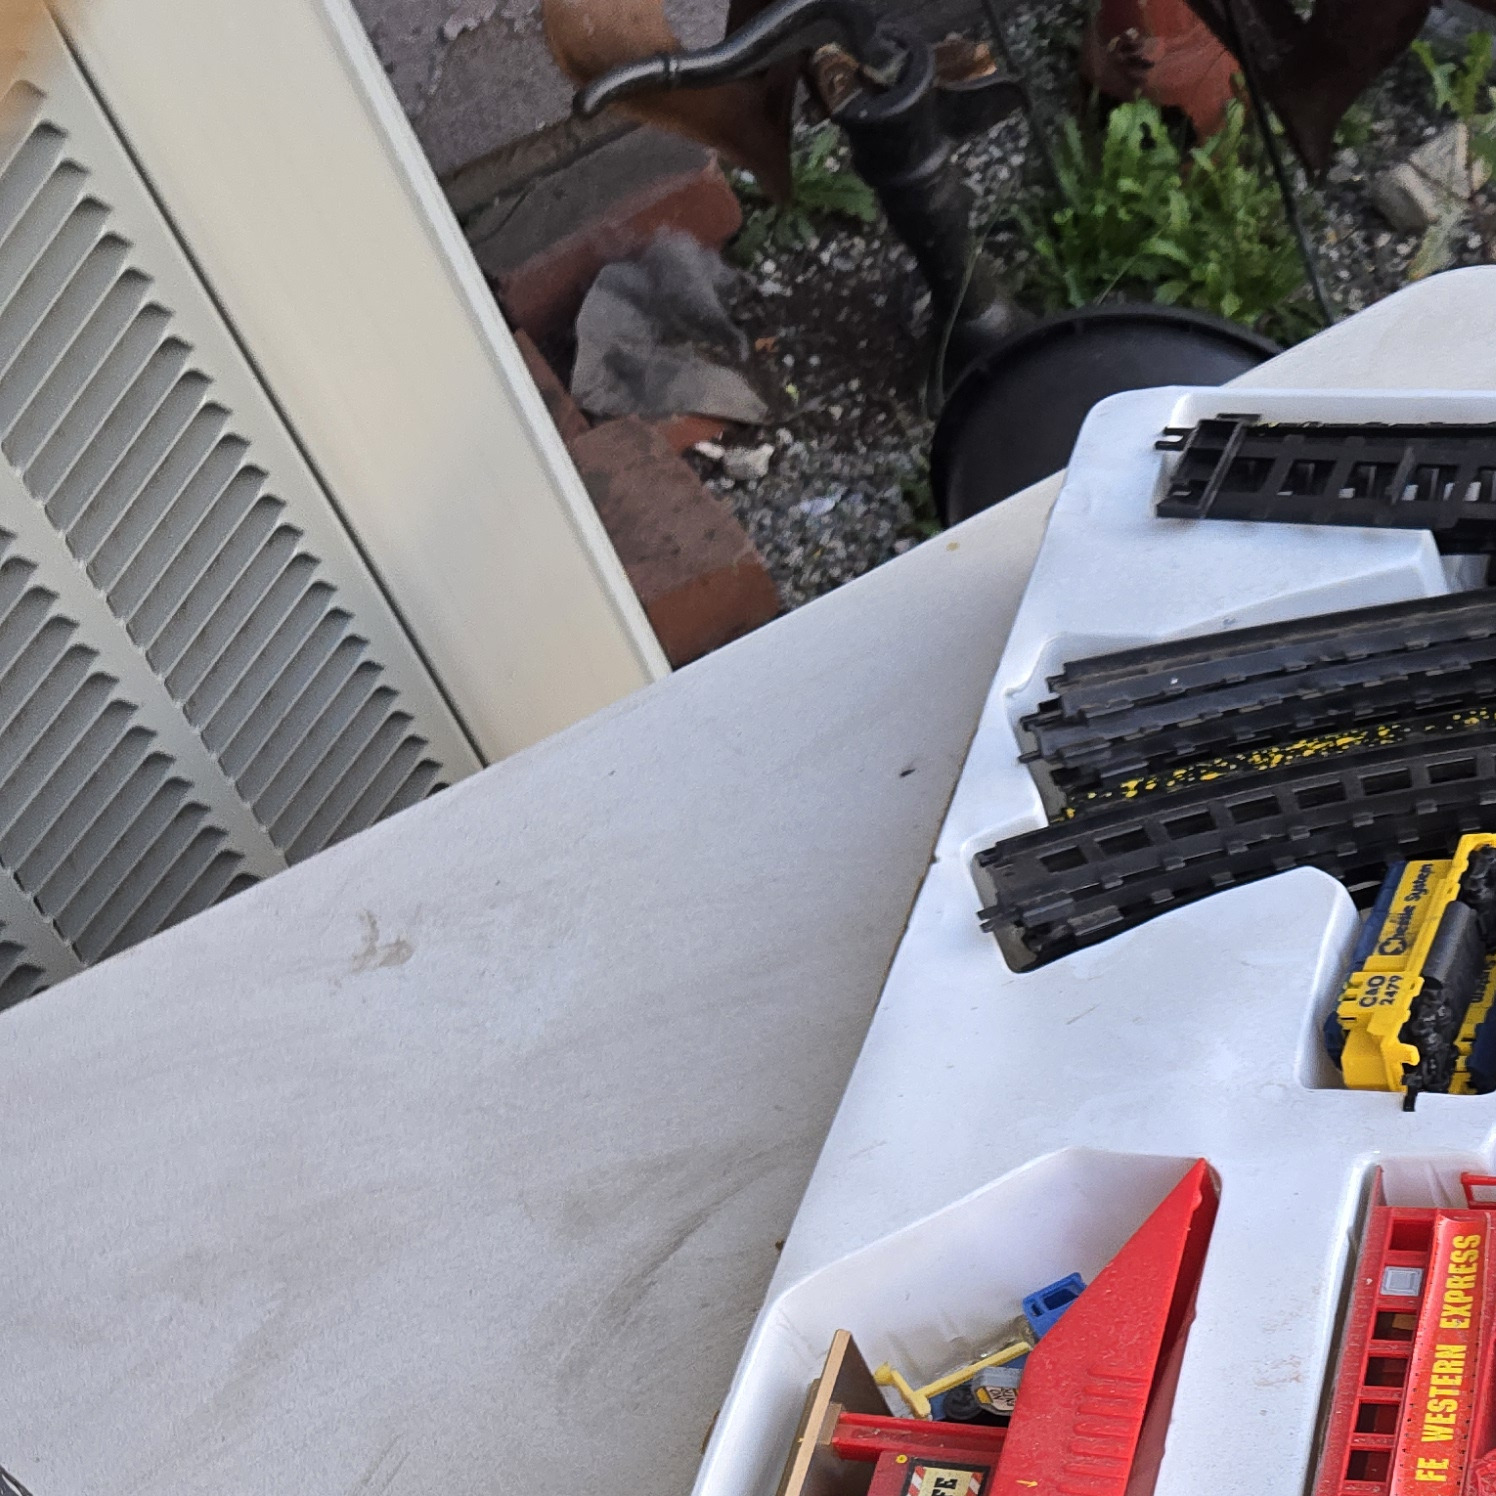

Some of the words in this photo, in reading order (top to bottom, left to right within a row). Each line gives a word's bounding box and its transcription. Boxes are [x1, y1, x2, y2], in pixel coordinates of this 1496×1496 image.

[1405, 863, 1433, 901] System
[1358, 975, 1385, 1008] C&O
[1379, 976, 1404, 1005] 2479
[1439, 1234, 1481, 1329] EXPRESS
[1421, 1343, 1467, 1442] WESTERN
[1417, 1457, 1450, 1482] FE
